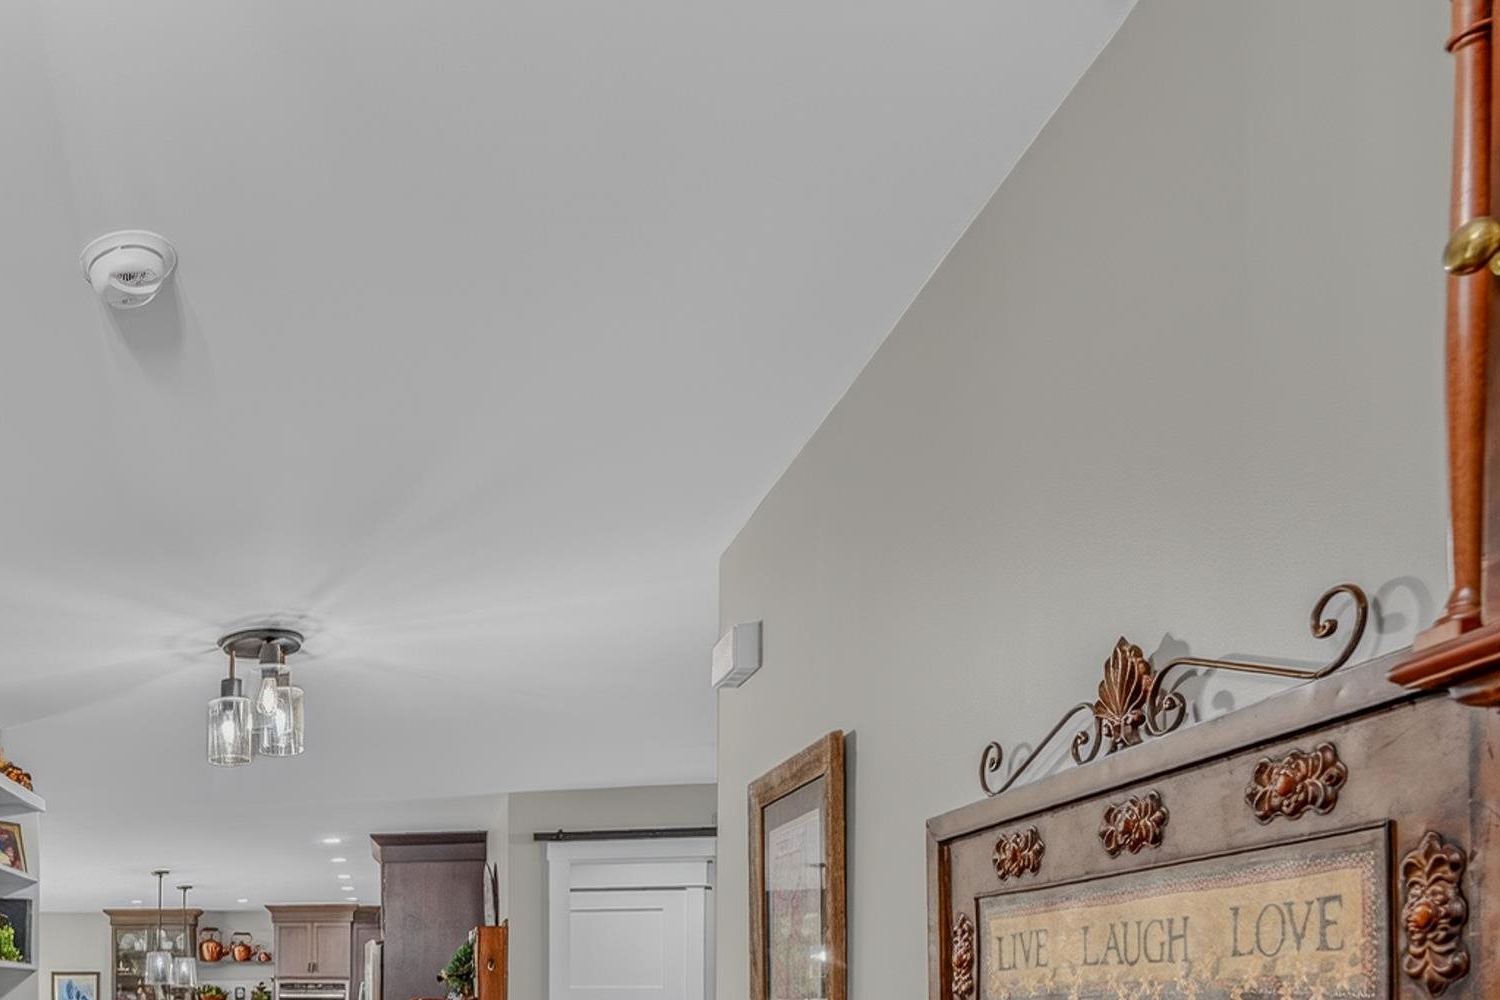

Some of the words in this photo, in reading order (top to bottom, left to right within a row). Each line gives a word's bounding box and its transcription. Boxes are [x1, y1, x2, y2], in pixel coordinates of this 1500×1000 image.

[996, 928, 1048, 971] LIVE
[1081, 916, 1190, 966] LAUGH
[1229, 894, 1344, 957] LOVE
